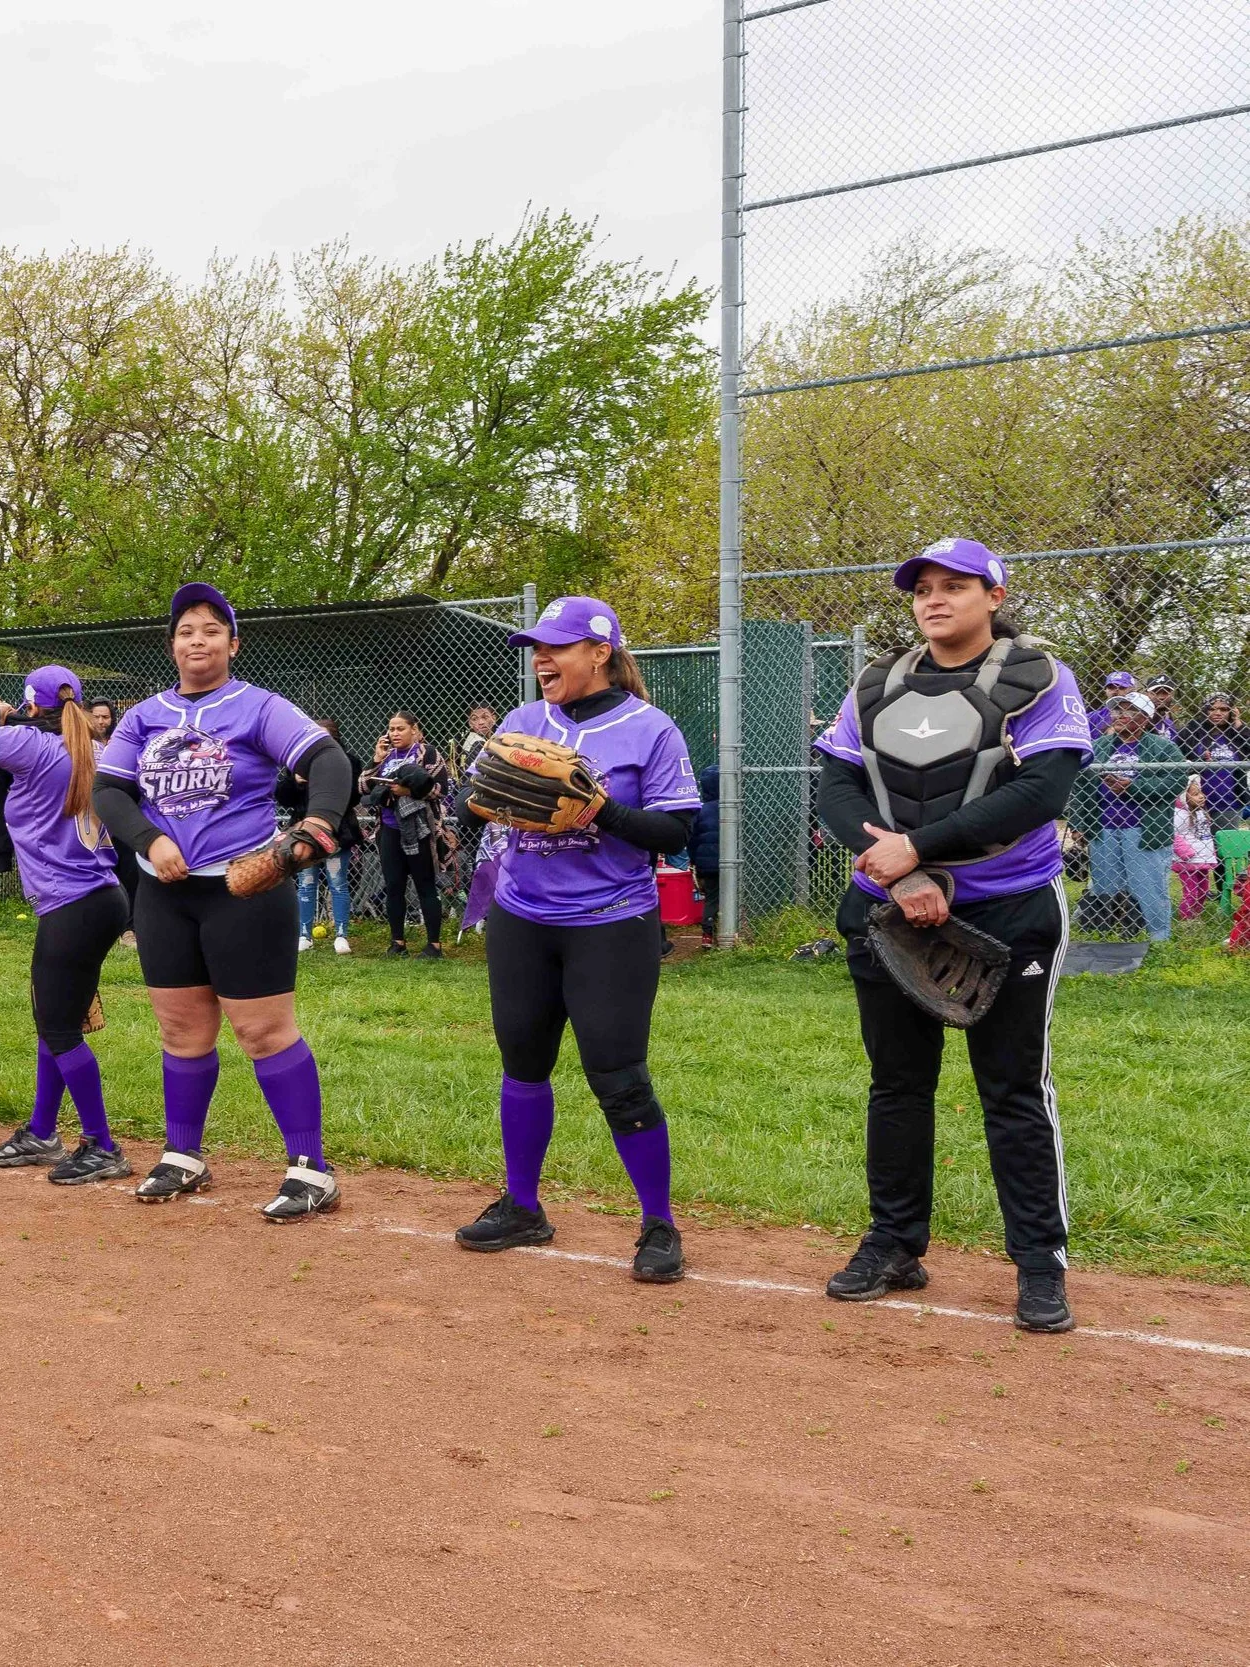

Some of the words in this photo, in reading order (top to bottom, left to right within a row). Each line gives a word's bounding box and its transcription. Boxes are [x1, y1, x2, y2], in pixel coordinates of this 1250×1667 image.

[146, 762, 164, 770] THE
[139, 766, 233, 801] STORM
[518, 840, 527, 848] We
